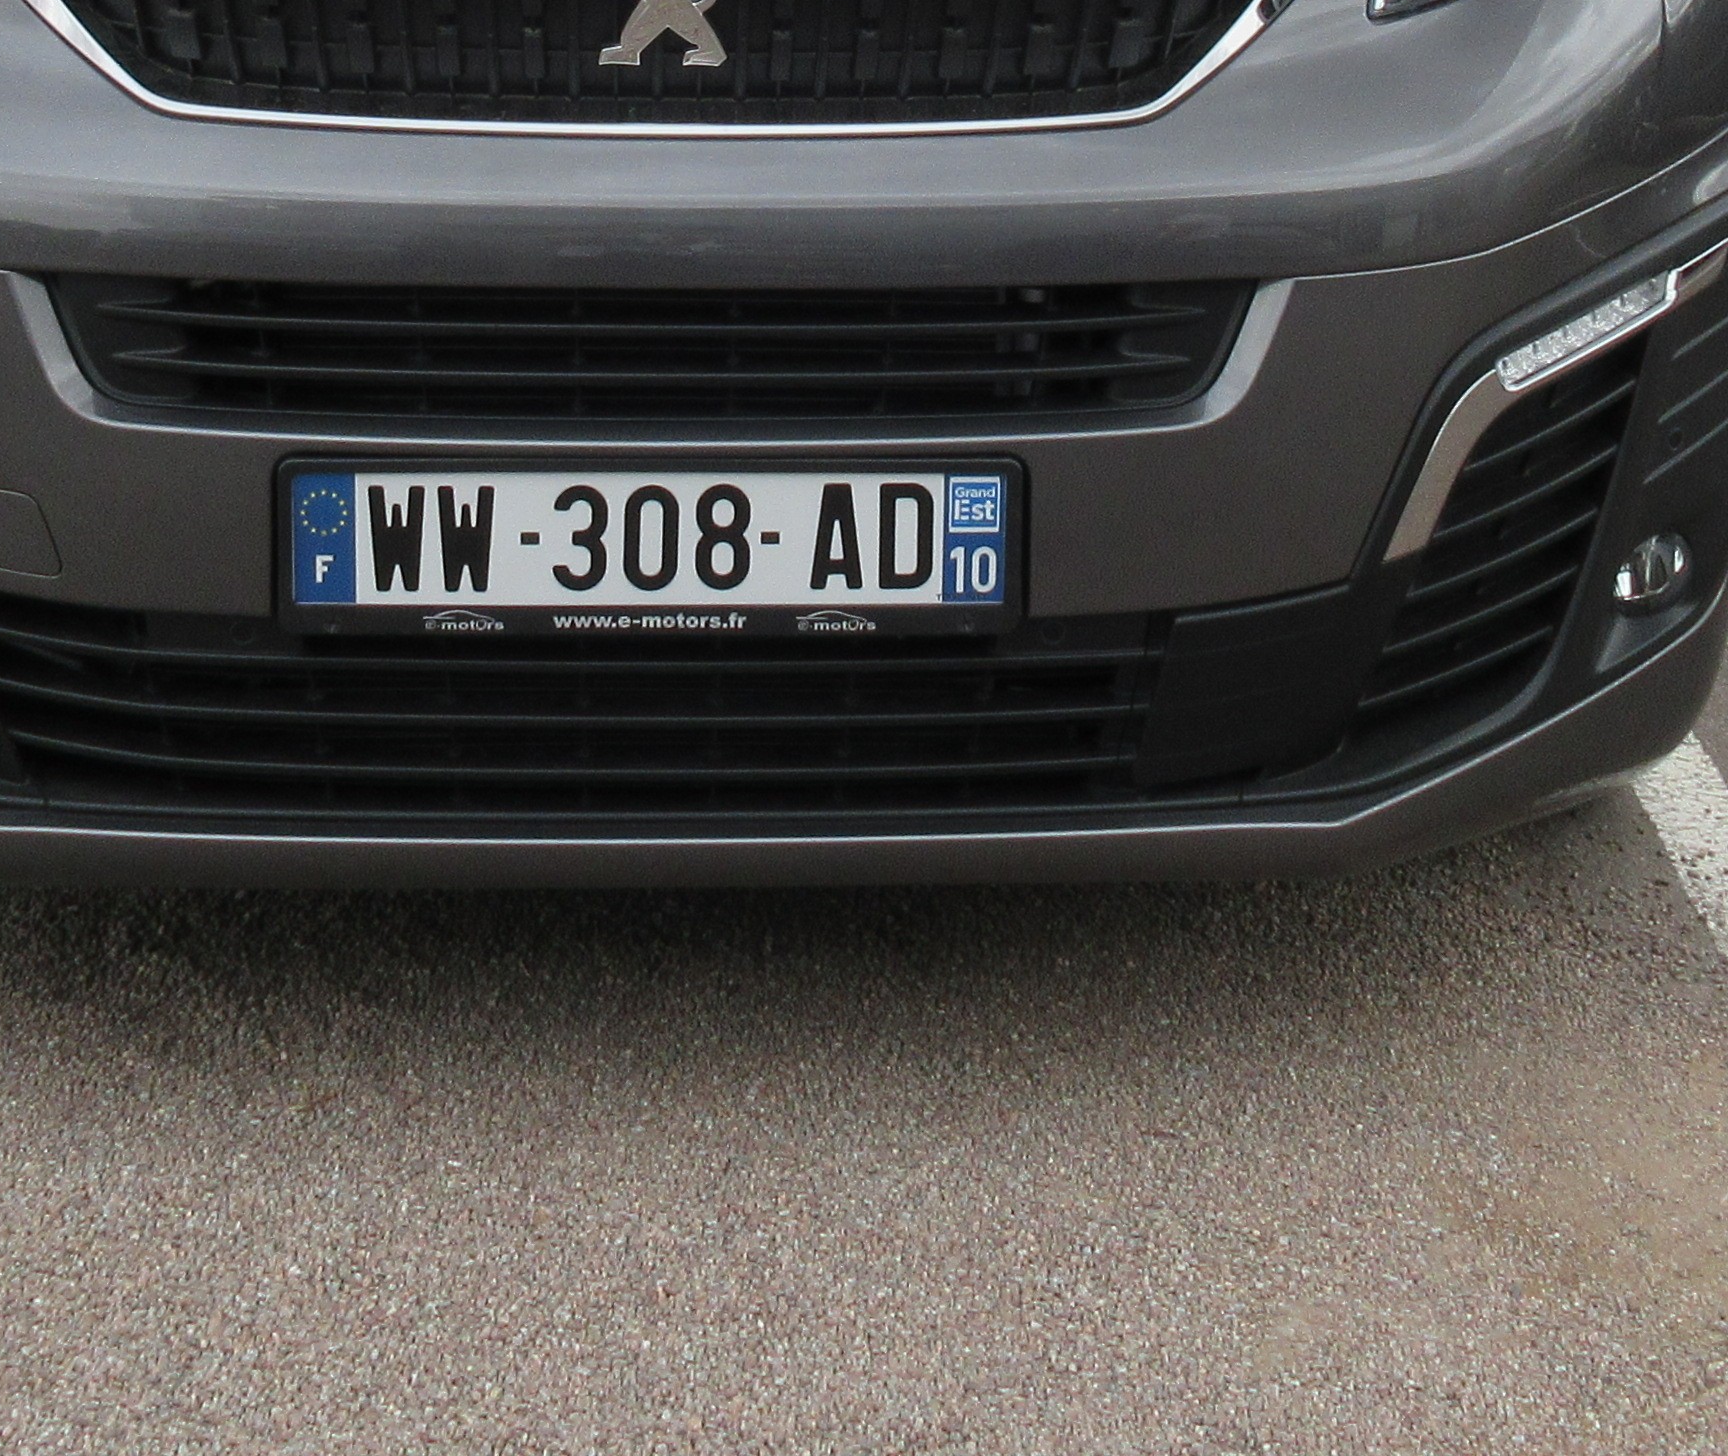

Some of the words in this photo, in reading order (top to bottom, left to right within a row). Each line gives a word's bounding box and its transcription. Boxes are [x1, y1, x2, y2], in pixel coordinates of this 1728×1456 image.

[954, 486, 996, 499] Grand
[953, 499, 995, 521] Est
[367, 482, 935, 592] WW-308-AD
[315, 554, 335, 584] F
[949, 545, 997, 594] 10
[552, 612, 748, 630] www.e-motors.fr
